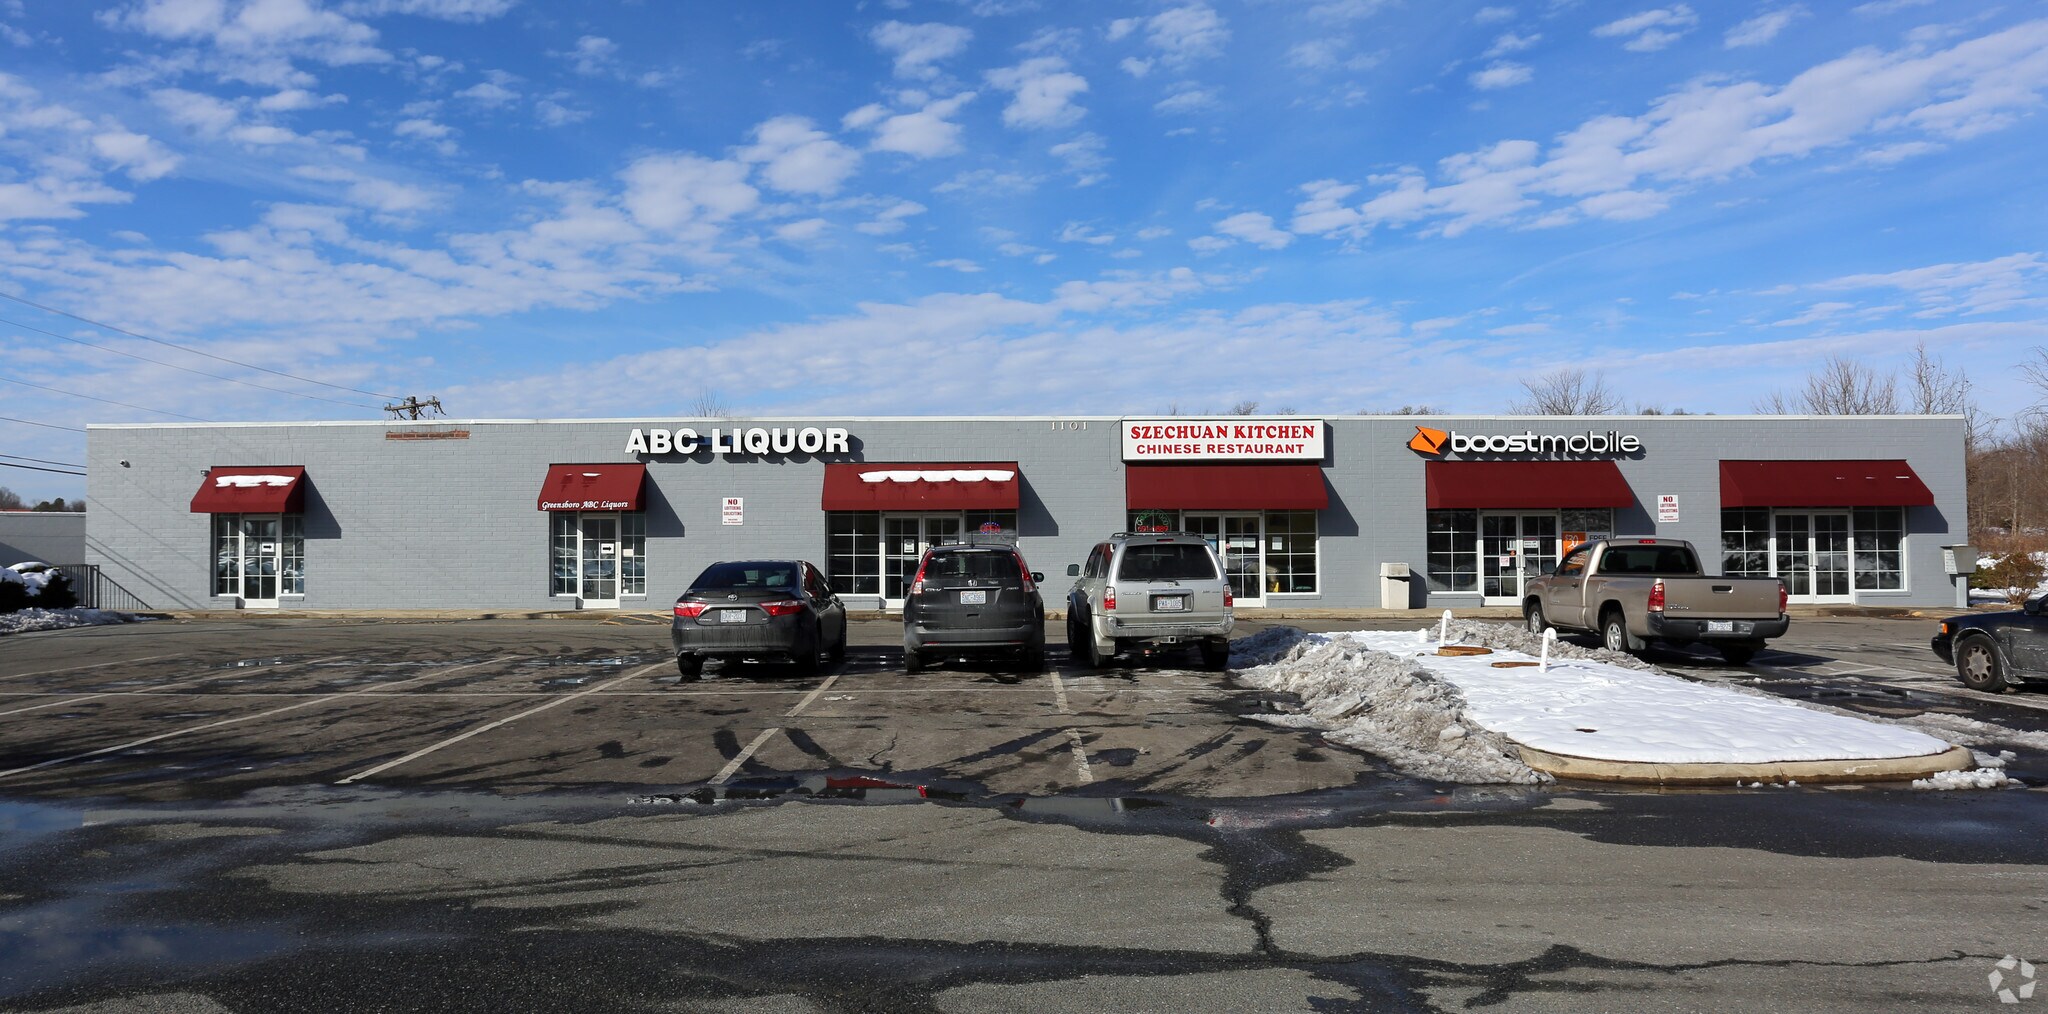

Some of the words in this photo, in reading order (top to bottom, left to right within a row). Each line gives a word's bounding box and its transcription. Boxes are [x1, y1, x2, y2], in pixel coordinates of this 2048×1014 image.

[1051, 421, 1088, 431] 1101
[1131, 426, 1229, 439] SZECHUAN
[1234, 426, 1315, 438] KITCHEN
[625, 428, 699, 454] ABC
[712, 427, 850, 455] LIQUOR
[1450, 430, 1640, 452] boostmobile
[1136, 444, 1202, 454] CHINESE
[1207, 444, 1304, 454] RESTAURANT
[542, 500, 580, 510] Greensboro
[581, 501, 599, 509] ABC
[601, 501, 628, 510] Liquors
